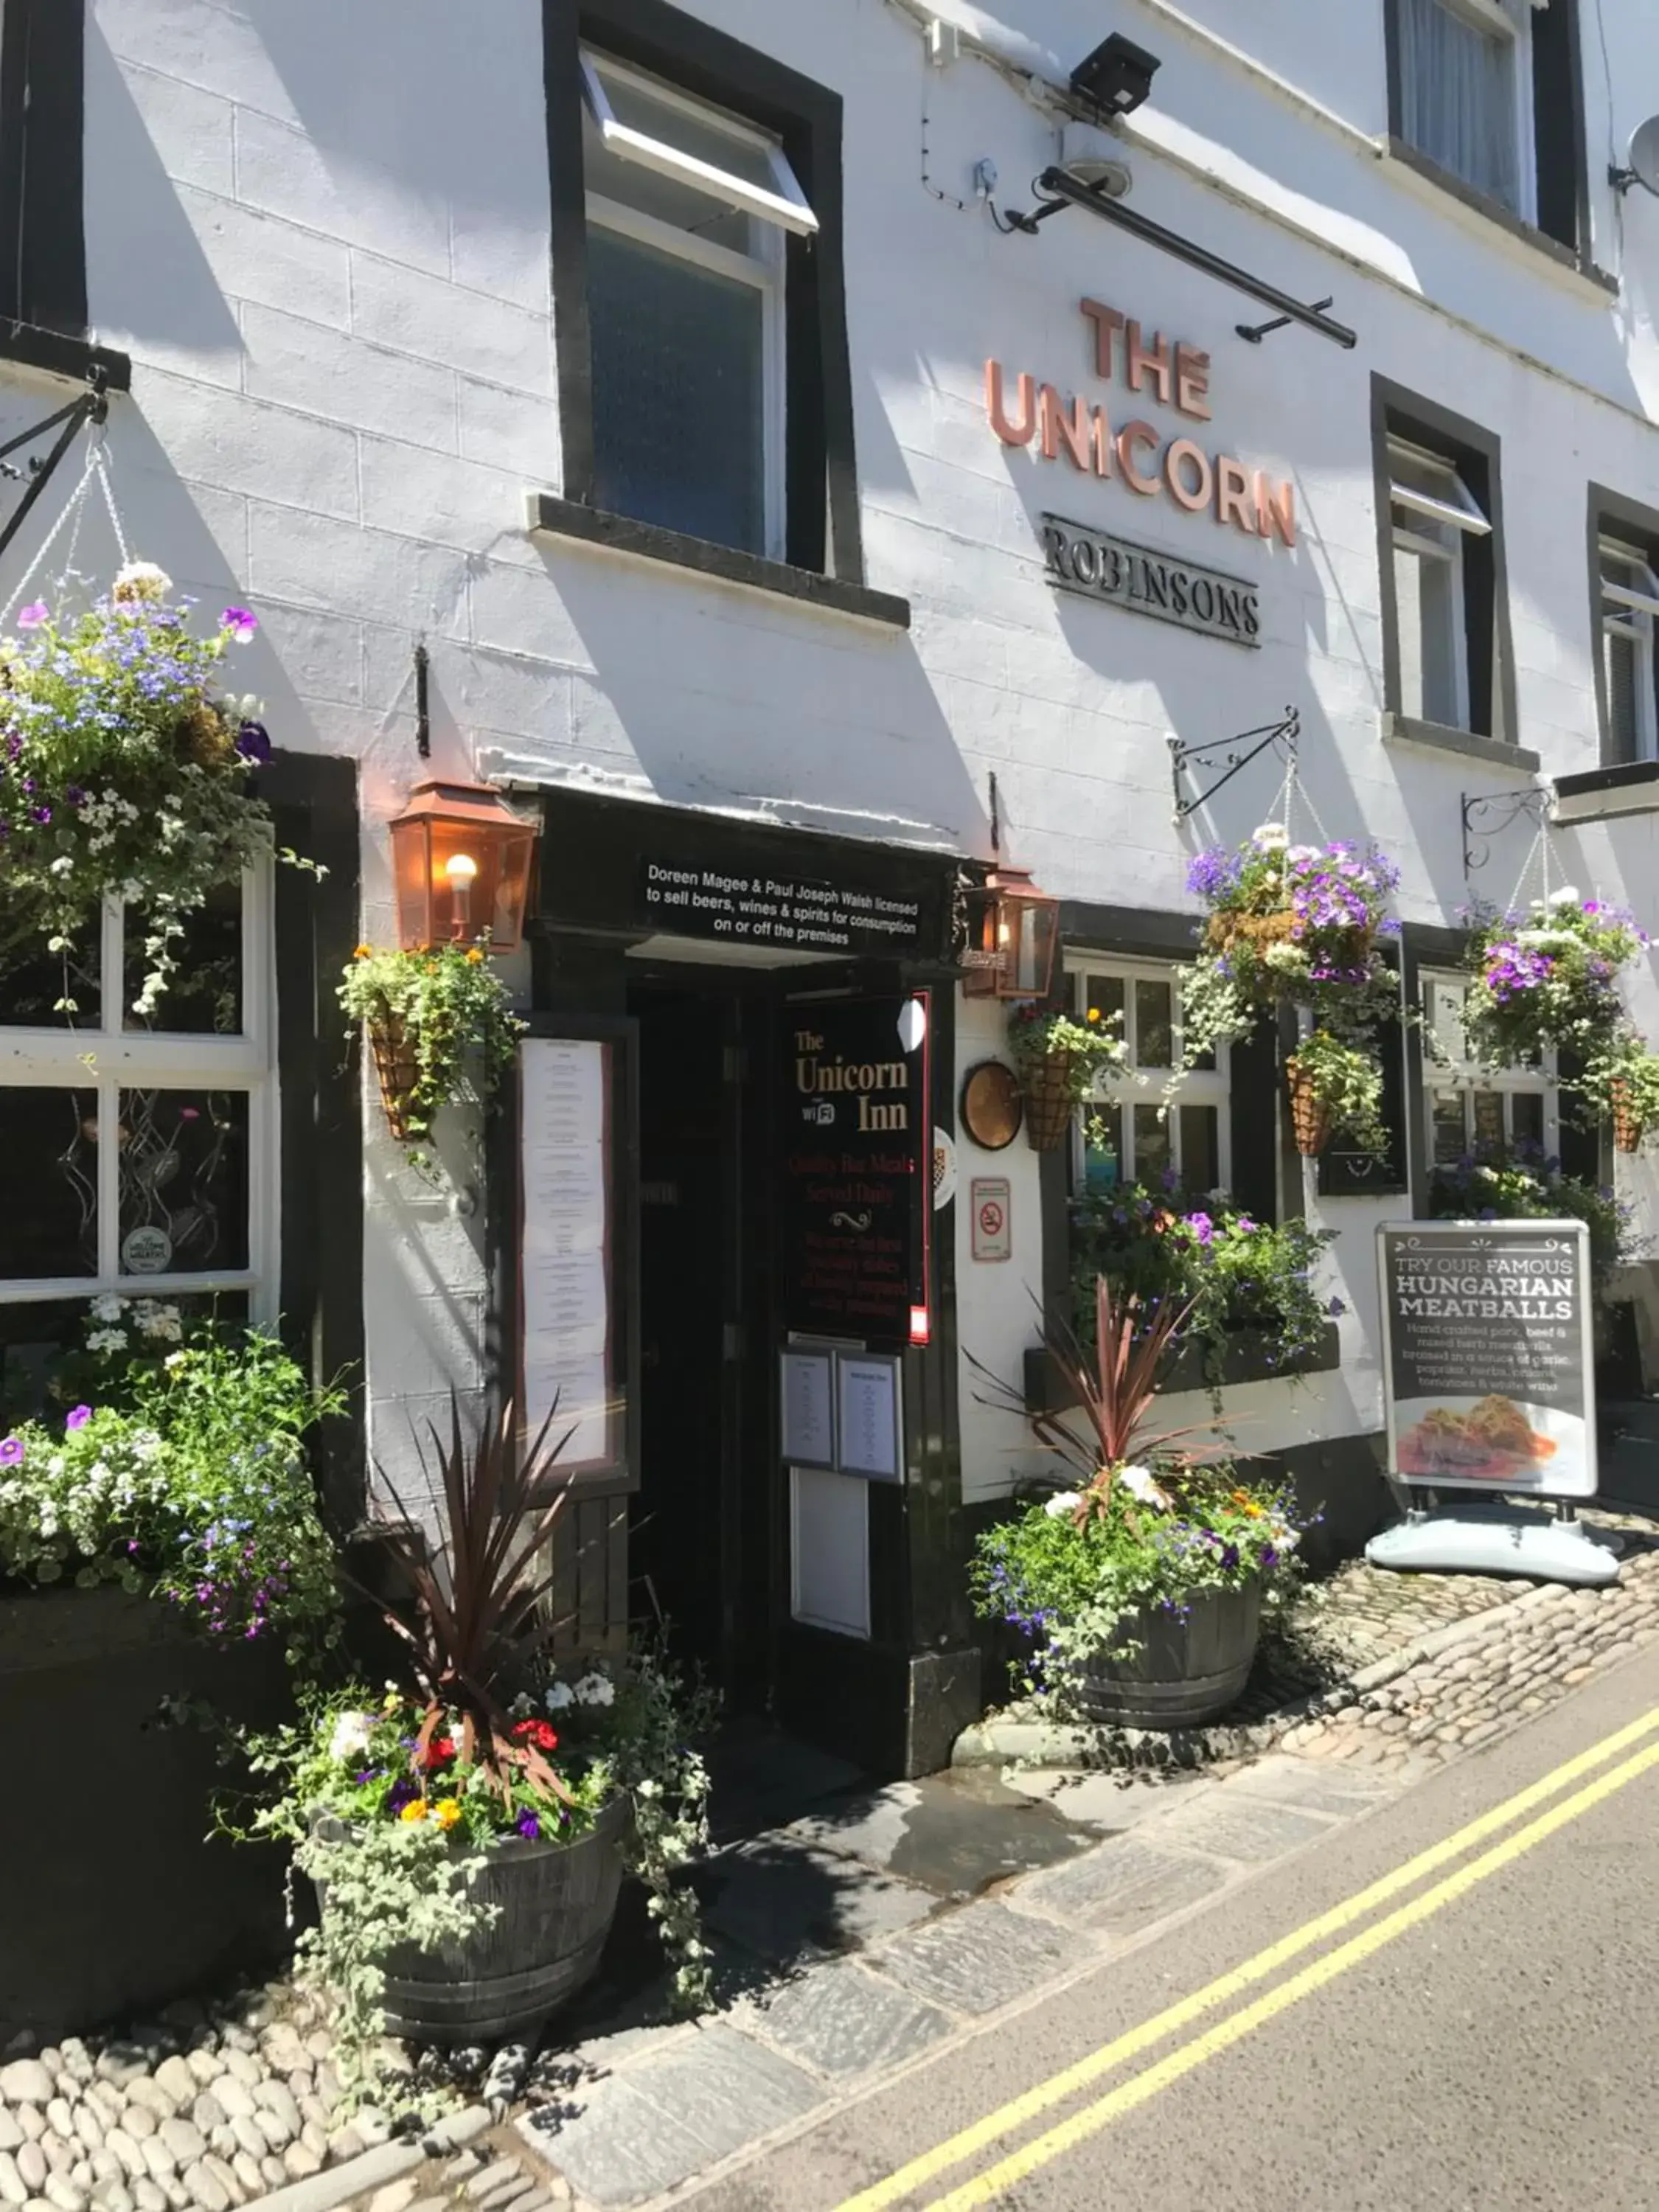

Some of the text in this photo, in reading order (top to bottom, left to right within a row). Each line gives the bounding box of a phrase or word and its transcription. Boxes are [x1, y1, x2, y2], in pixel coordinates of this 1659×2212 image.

[1080, 296, 1212, 421] THE
[983, 357, 1295, 548] UNICORN
[1041, 526, 1260, 639] ROBINSONS
[648, 864, 918, 916] Doreen Magee & Paul Joseph Walsh licensed
[647, 887, 917, 935] to sell beers, wines & spirits for consumption
[714, 919, 849, 945] on or off the premises
[795, 1031, 824, 1051] The
[796, 1056, 908, 1093] Unicorn
[857, 1095, 908, 1131] Inn
[1394, 1258, 1573, 1275] TRY OUR FAMOUS
[1396, 1276, 1573, 1296] HUNGARIAN
[1399, 1298, 1572, 1319] MEATBALLS
[1526, 1326, 1554, 1338] beef
[1557, 1326, 1566, 1338] &
